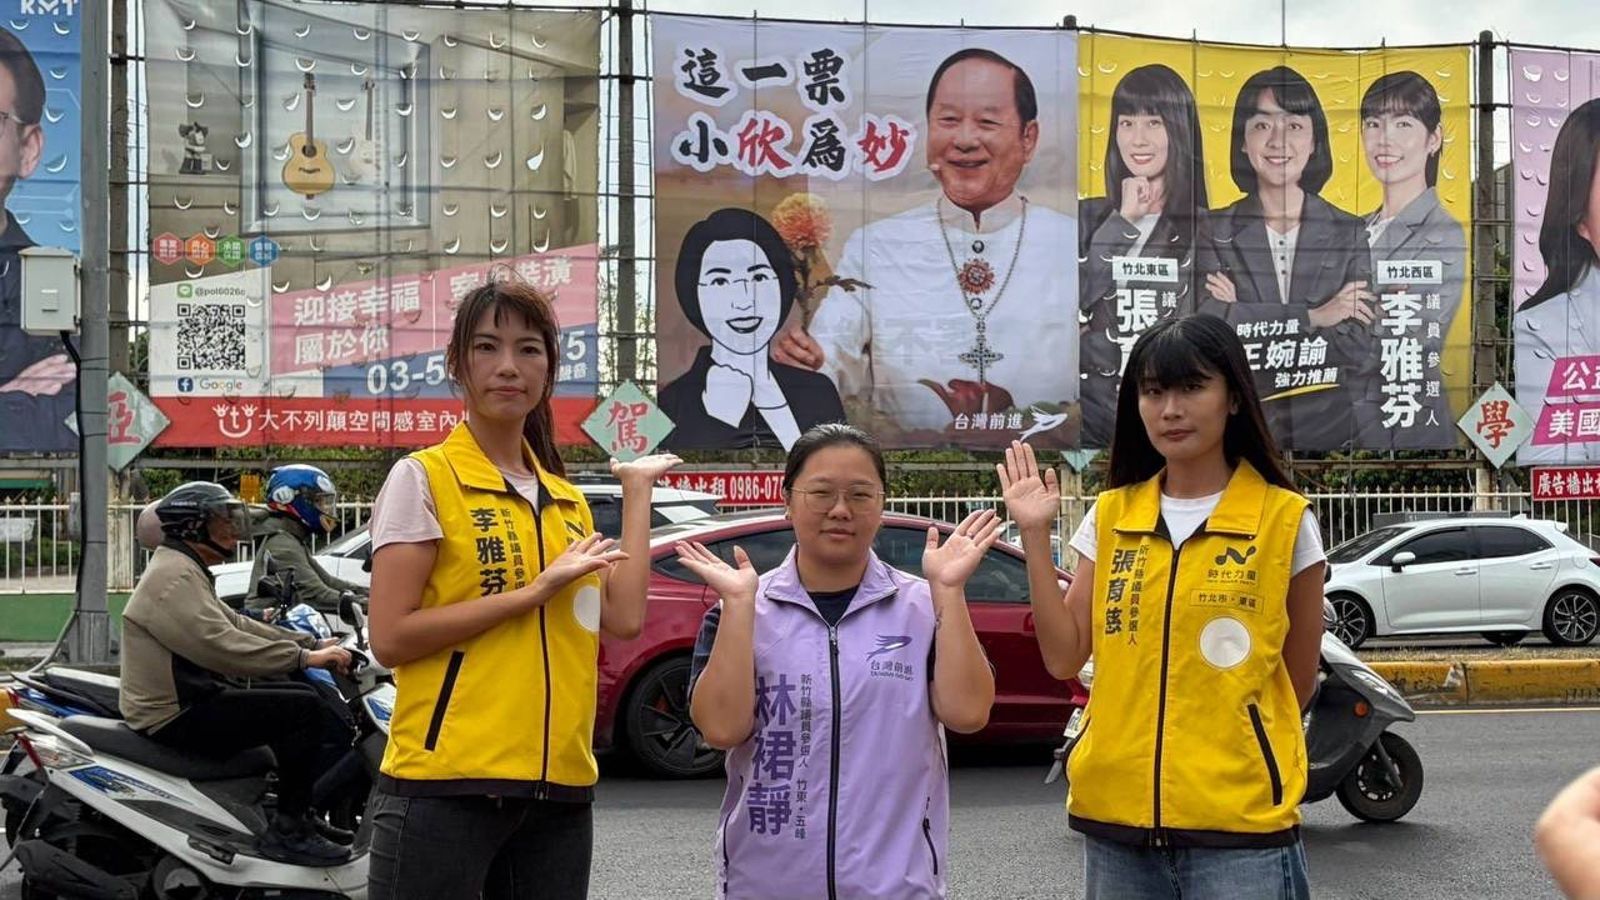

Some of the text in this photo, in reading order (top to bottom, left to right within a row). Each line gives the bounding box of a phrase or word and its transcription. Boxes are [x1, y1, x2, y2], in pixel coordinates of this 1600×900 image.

[20, 0, 79, 16] KMT
[681, 48, 845, 105] 這一票
[1122, 263, 1170, 277] 竹北東區
[1387, 265, 1434, 279] 竹北西區
[294, 281, 420, 326] 迎接幸福
[1236, 320, 1300, 337] 時代力量
[295, 325, 389, 365] 屬於你
[1380, 291, 1424, 429] 李雅芬
[1425, 294, 1441, 427] 議員參選人
[200, 378, 242, 392] Google
[367, 353, 450, 395] 03-5
[1275, 369, 1339, 388] 強力推薦
[259, 408, 468, 433] 大不列顛空間感室內
[605, 401, 649, 454] 駕
[954, 413, 1023, 431] 台灣前進
[1476, 400, 1515, 449] 學
[1548, 407, 1600, 438] 美國
[470, 507, 508, 597] 李雅芬
[1207, 569, 1256, 581] 時代力量
[1127, 544, 1150, 647] 新竹縣議員參選人
[870, 660, 913, 676] 台灣前進
